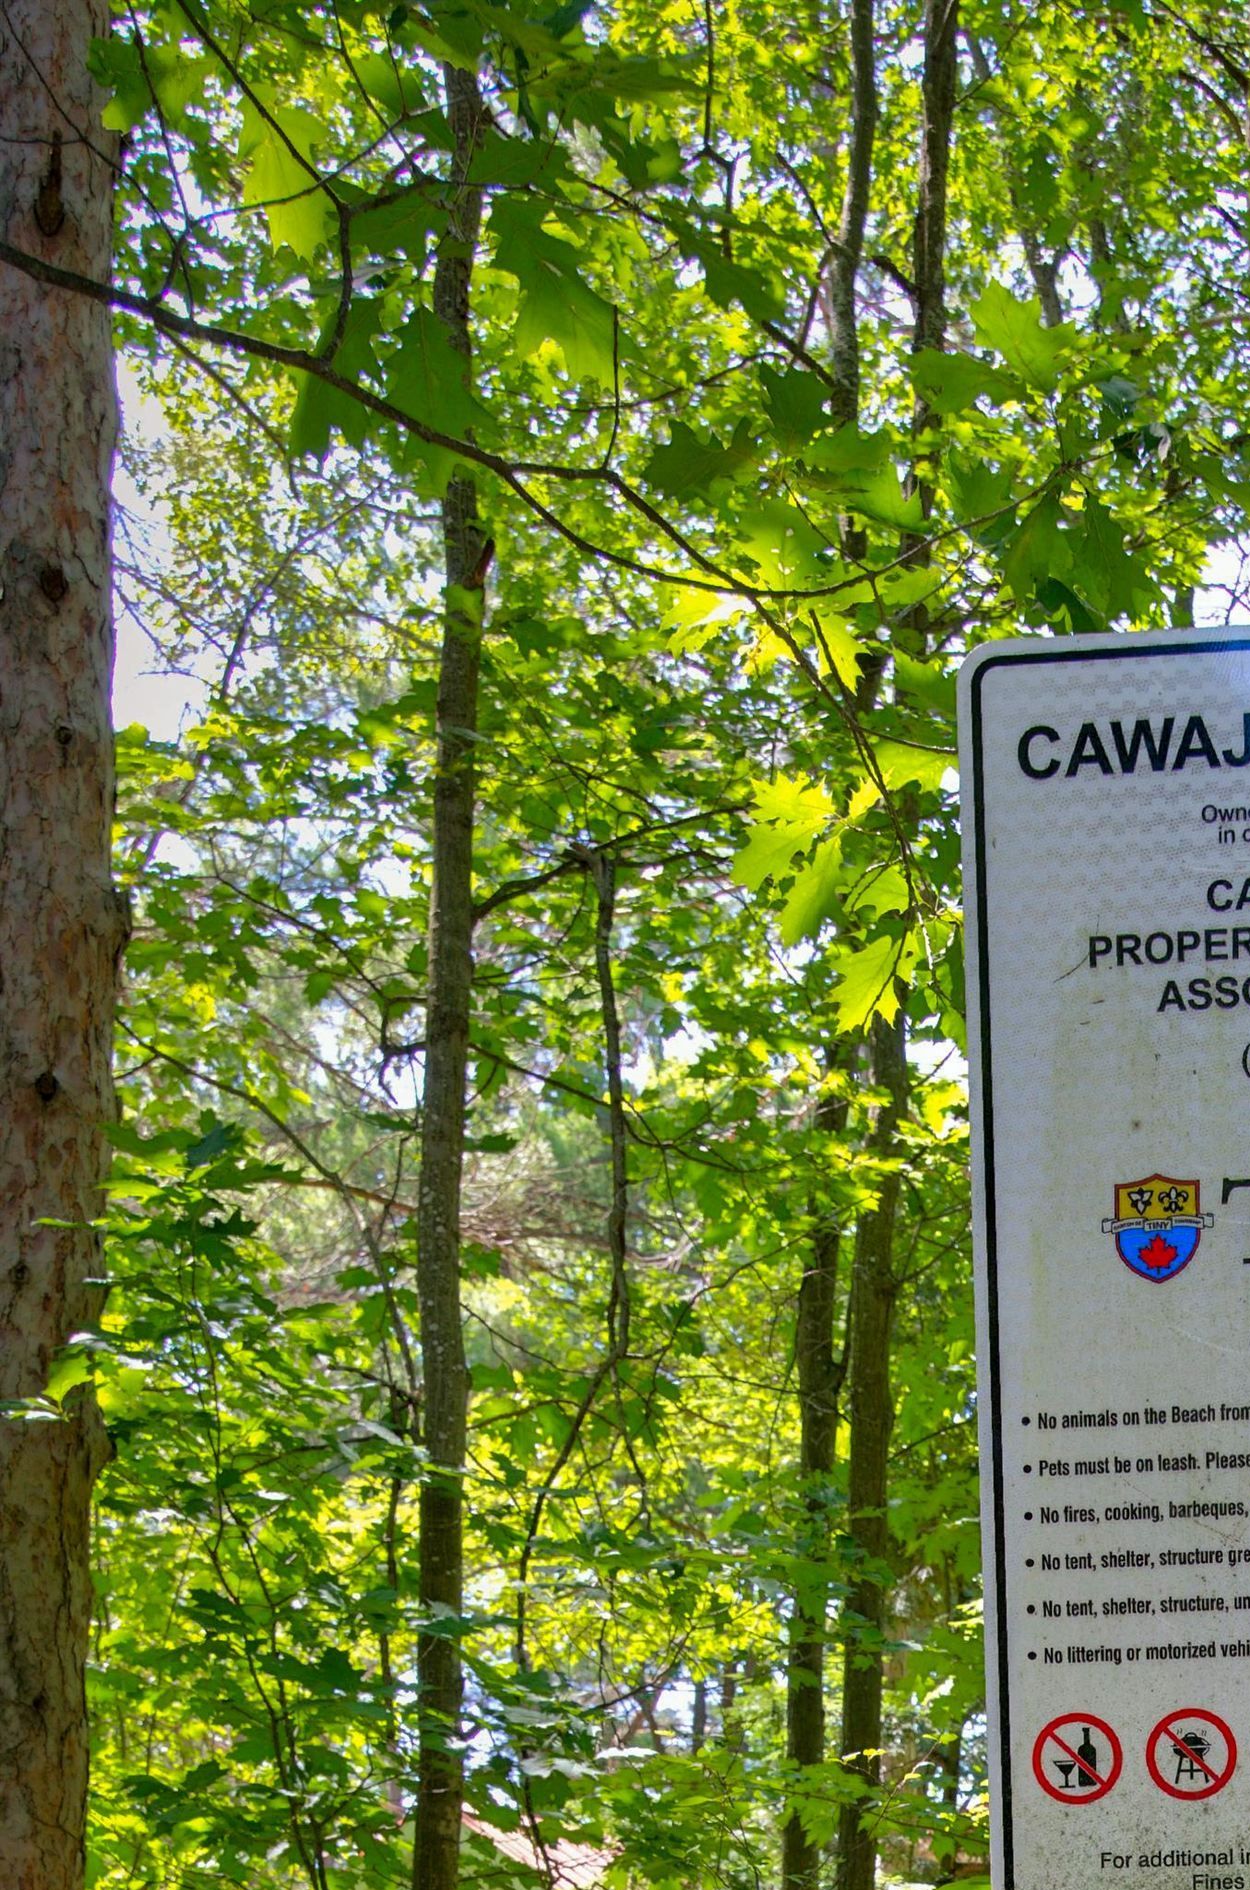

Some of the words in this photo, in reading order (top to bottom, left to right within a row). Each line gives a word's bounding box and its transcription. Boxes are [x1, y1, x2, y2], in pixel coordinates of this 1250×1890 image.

[1217, 825, 1236, 844] in
[1038, 1413, 1057, 1429] No
[1062, 1410, 1118, 1428] animals
[1123, 1411, 1140, 1426] on
[1144, 1408, 1167, 1424] the
[1171, 1405, 1216, 1423] Beach
[1039, 1459, 1070, 1476] Pets
[1074, 1458, 1110, 1475] must
[1114, 1457, 1131, 1473] be
[1136, 1457, 1153, 1472] on
[1158, 1453, 1201, 1471] leash.
[1040, 1507, 1059, 1524] No
[1064, 1505, 1100, 1524] fires,
[1104, 1503, 1164, 1523] cooking,
[1169, 1501, 1249, 1520] barbeques,
[1041, 1554, 1060, 1571] No
[1065, 1553, 1097, 1571] tent,
[1101, 1550, 1155, 1569] shelter,
[1159, 1548, 1223, 1566] structure
[1043, 1601, 1062, 1618] No
[1067, 1599, 1098, 1618] tent,
[1102, 1597, 1156, 1616] shelter,
[1160, 1595, 1229, 1614] structure,
[1044, 1647, 1063, 1664] No
[1067, 1645, 1122, 1665] littering
[1127, 1646, 1141, 1661] or
[1145, 1641, 1216, 1660] motorized
[1100, 1852, 1132, 1869] For
[1138, 1849, 1234, 1869] additional
[1192, 1873, 1245, 1890] Fines
